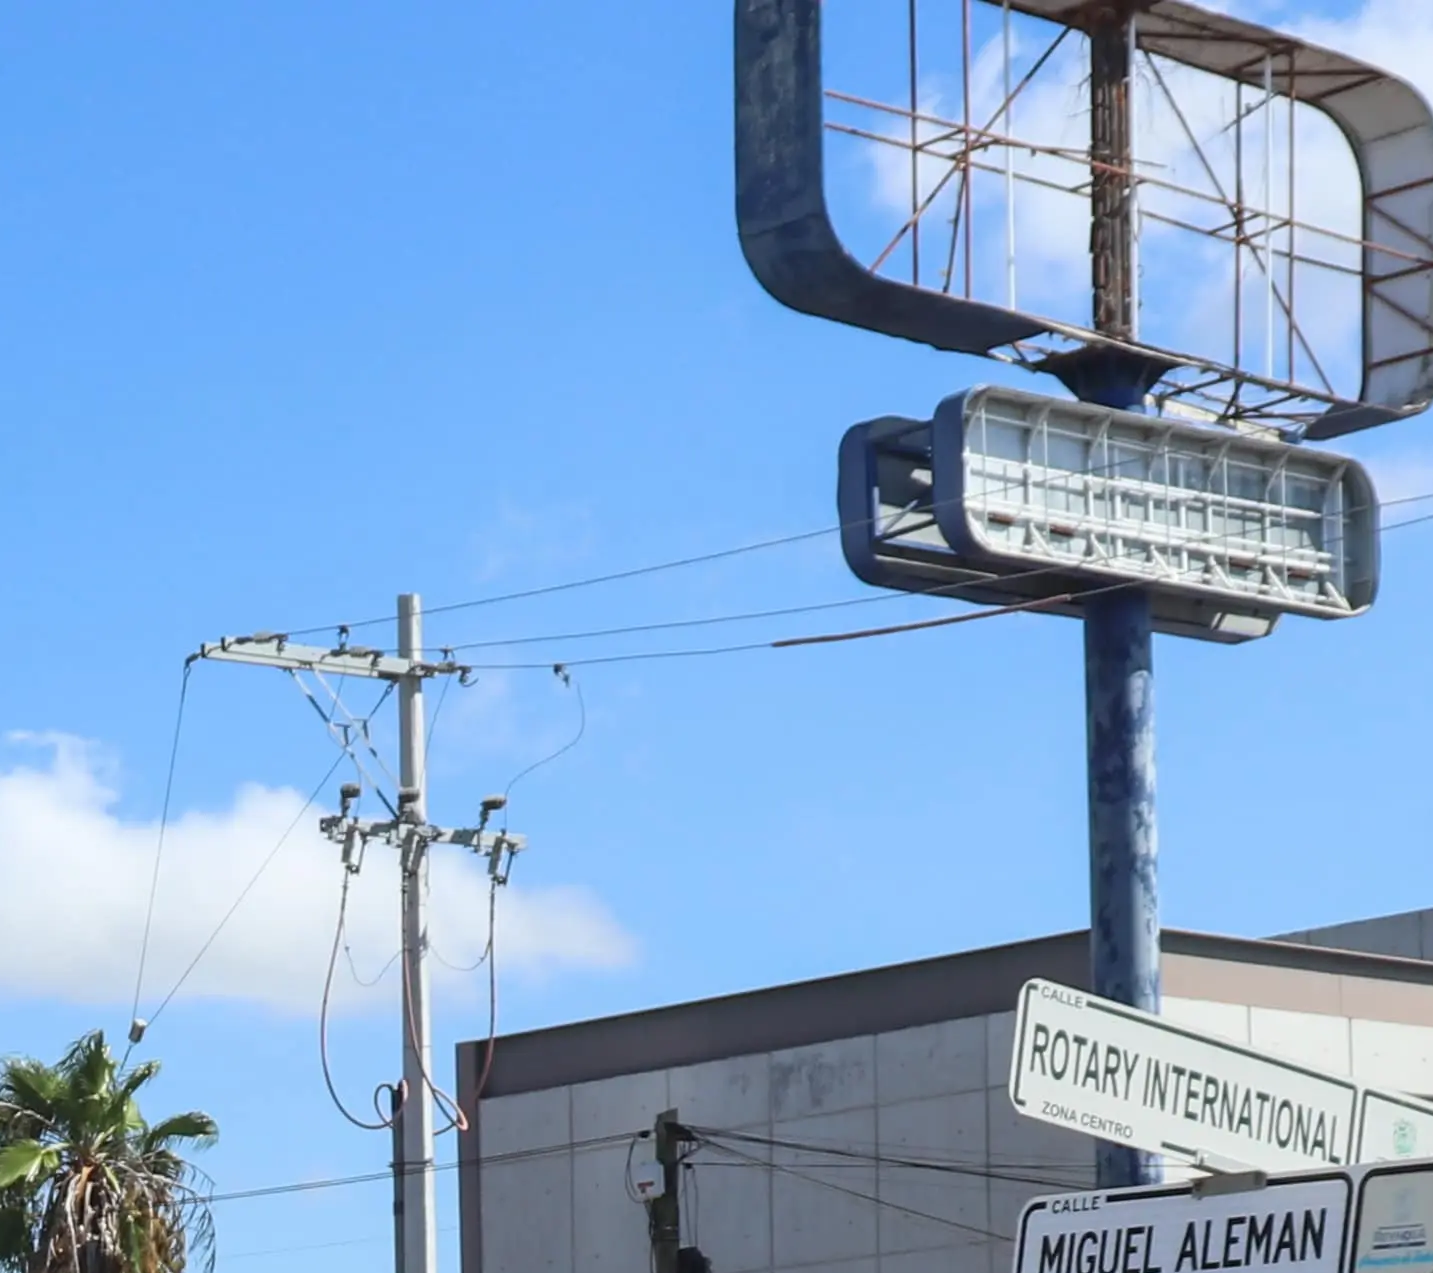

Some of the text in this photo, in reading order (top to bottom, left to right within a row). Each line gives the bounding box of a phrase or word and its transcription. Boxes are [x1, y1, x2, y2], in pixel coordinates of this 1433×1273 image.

[1040, 985, 1083, 1009] CALLE
[1030, 1023, 1342, 1165] ROTARY INTERNATIONAL
[1041, 1101, 1133, 1139] ZONA CENTRO
[1052, 1196, 1100, 1214] CALLE
[1174, 1207, 1327, 1273] ALEMAN
